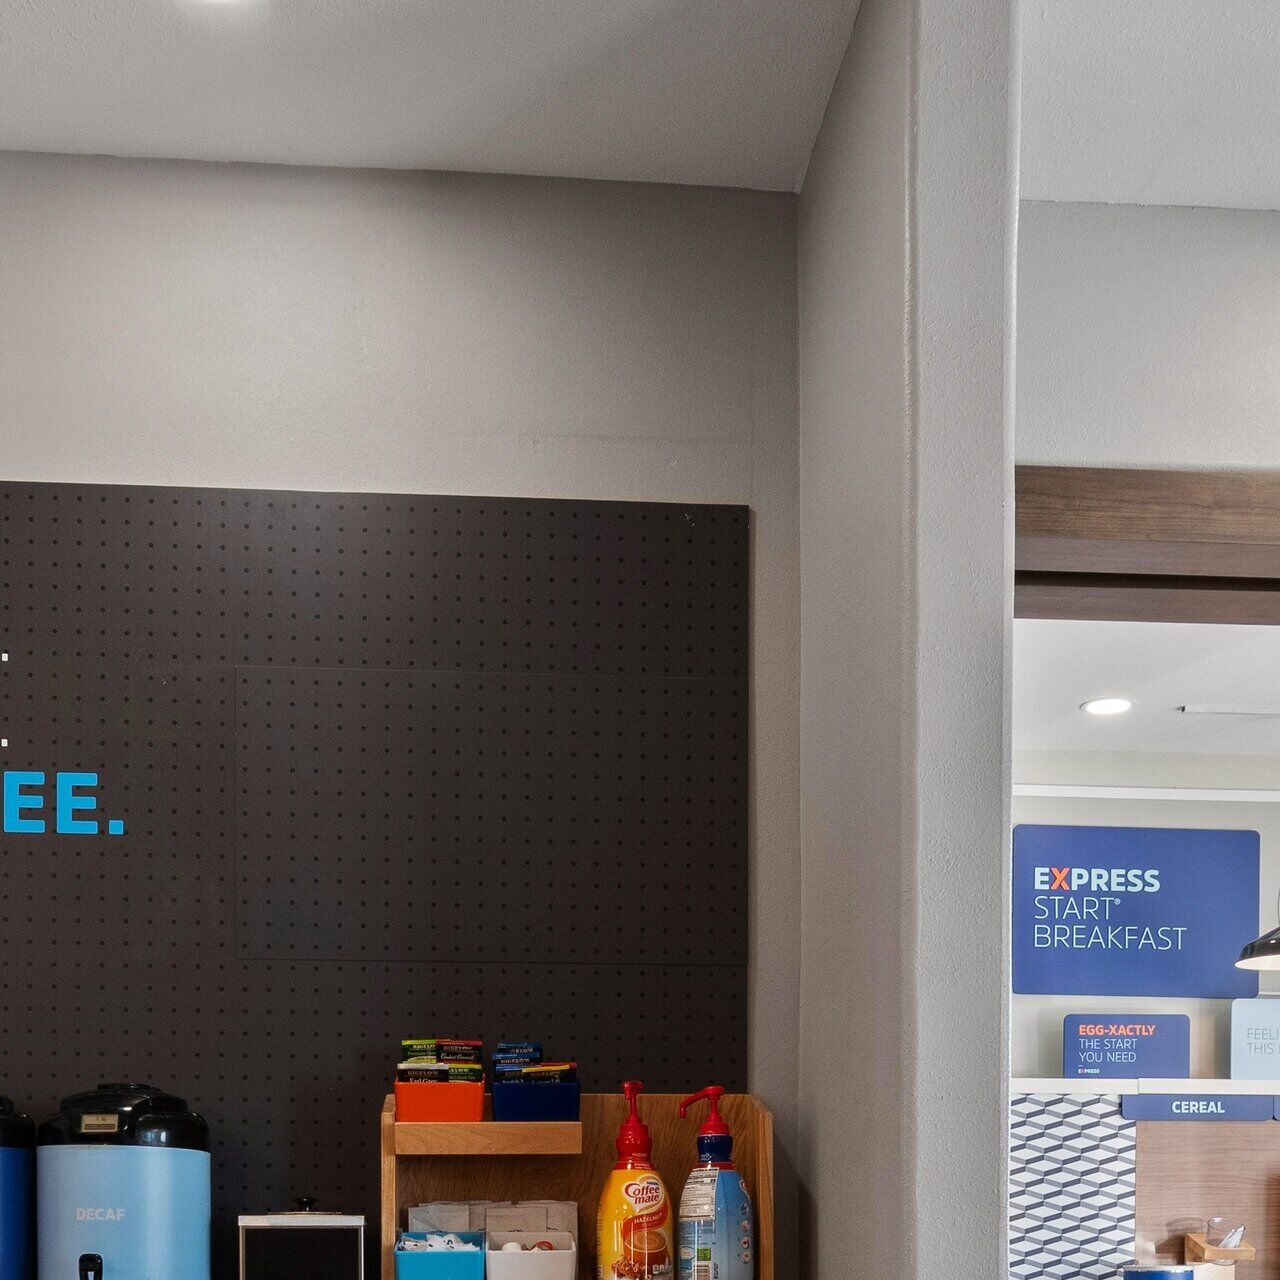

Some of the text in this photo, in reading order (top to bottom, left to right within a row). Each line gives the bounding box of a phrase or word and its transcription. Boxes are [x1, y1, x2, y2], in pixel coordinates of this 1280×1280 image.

[1034, 867, 1161, 893] EXPRESS
[1034, 924, 1188, 951] BREAKFAST
[1078, 1024, 1156, 1036] EGG-XACTLY
[1078, 1038, 1138, 1050] THE START
[1246, 1042, 1275, 1055] THIS
[1078, 1051, 1137, 1063] YOU NEED
[1171, 1101, 1225, 1114] CEREAL
[624, 1183, 660, 1198] Coffee
[634, 1194, 660, 1205] mate
[76, 1207, 125, 1222] DECAF
